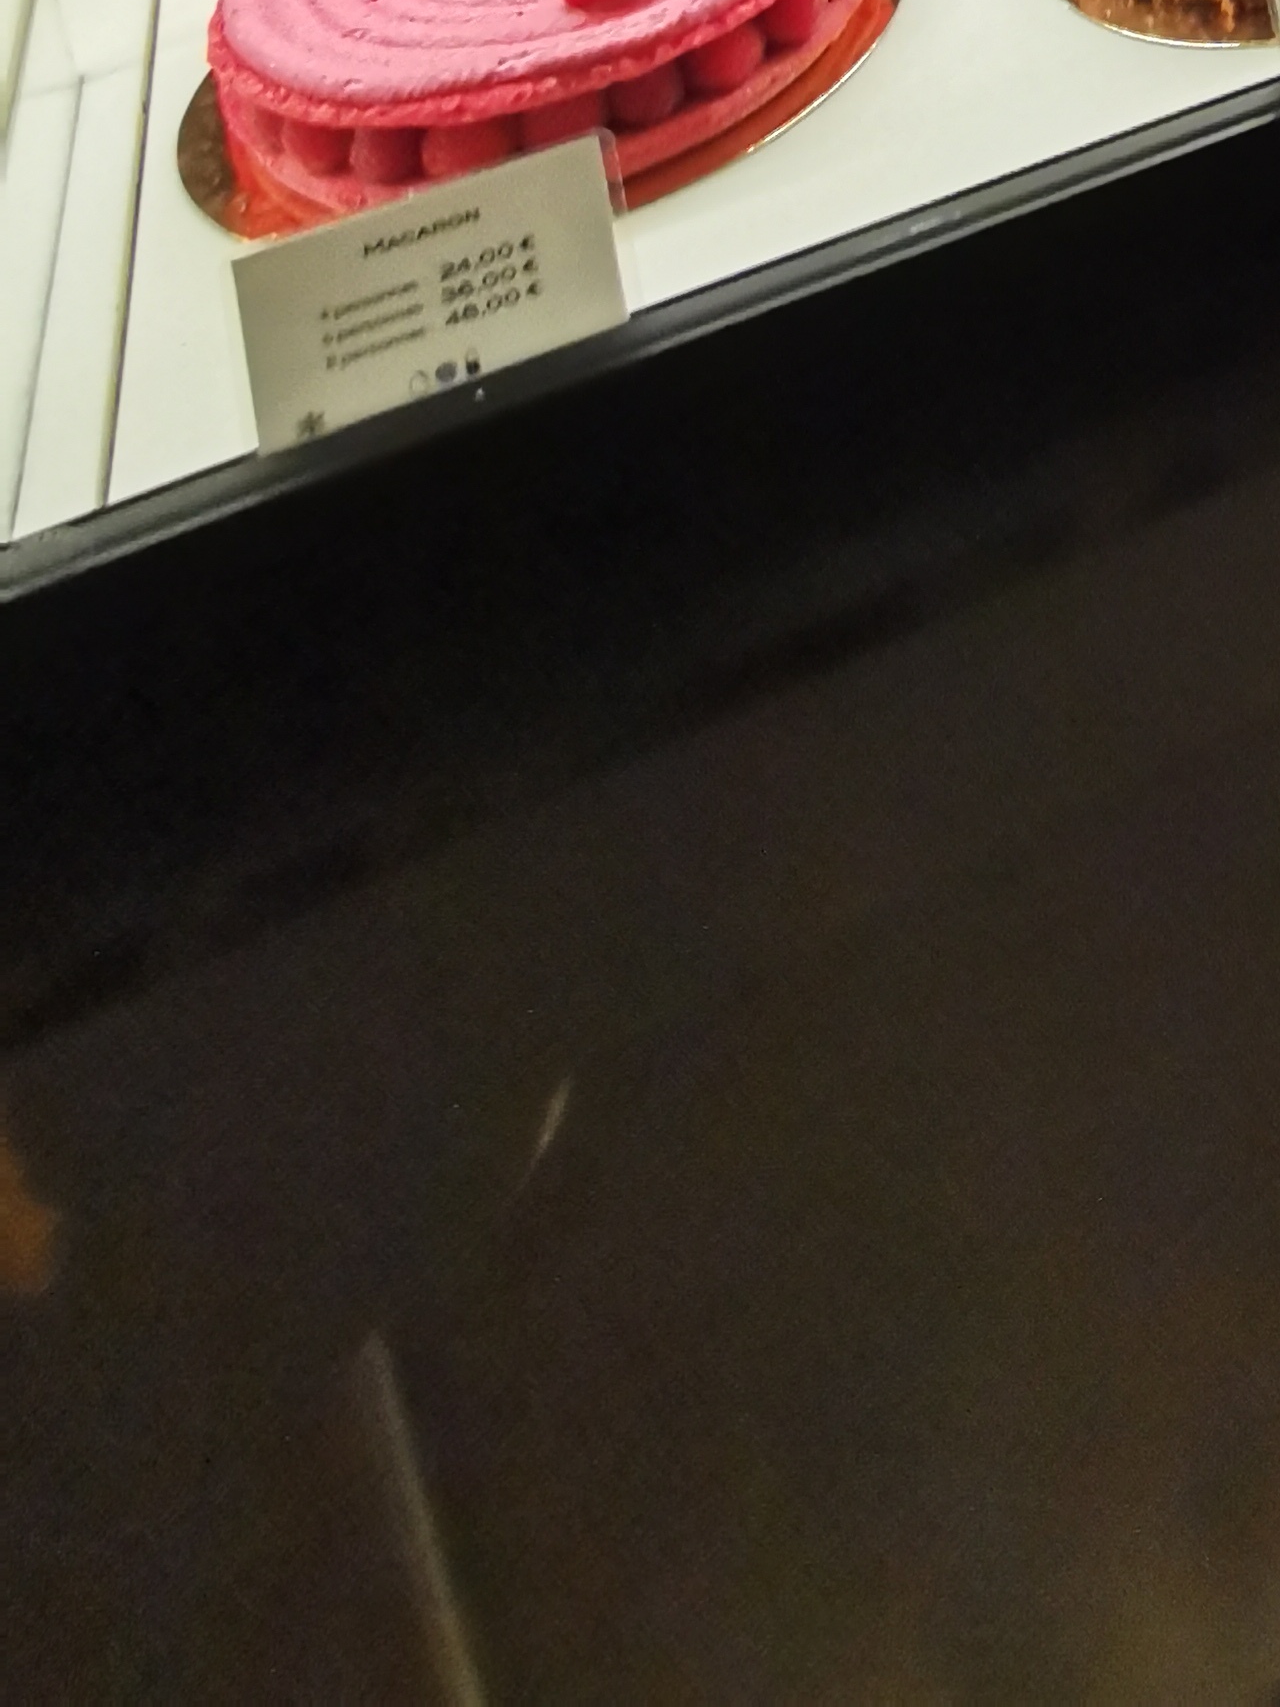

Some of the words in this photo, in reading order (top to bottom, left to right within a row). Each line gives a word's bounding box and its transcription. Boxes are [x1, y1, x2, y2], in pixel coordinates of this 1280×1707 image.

[363, 206, 481, 259] MACARON
[439, 243, 514, 283] 24,00
[519, 232, 536, 253] €
[522, 255, 539, 276] €
[525, 278, 542, 299] €
